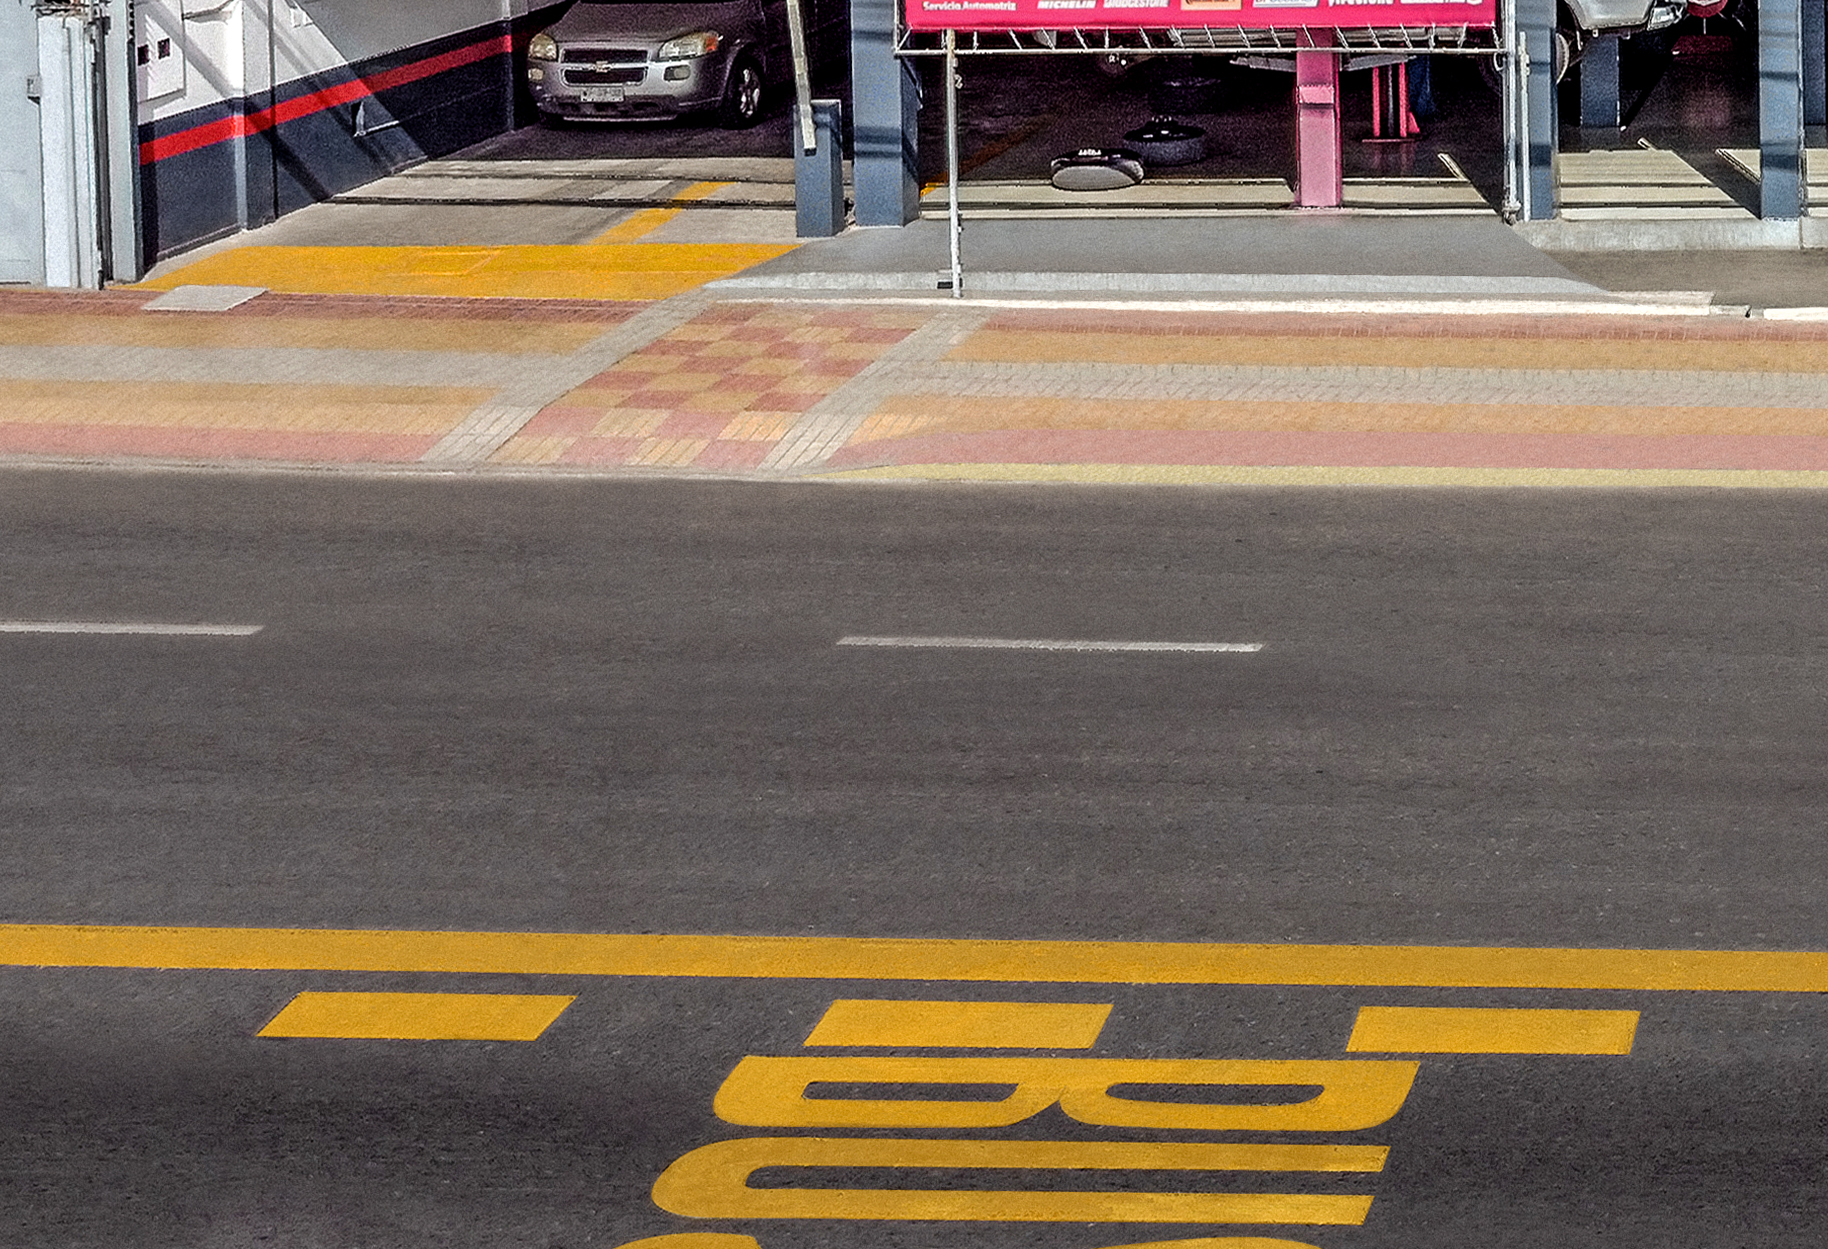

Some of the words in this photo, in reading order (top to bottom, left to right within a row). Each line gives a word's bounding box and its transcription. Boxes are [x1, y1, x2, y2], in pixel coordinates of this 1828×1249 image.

[923, 1, 961, 11] Servicio
[963, 1, 1017, 11] Automotriz
[1037, 0, 1097, 10] MICHELIN
[614, 1055, 1422, 1249] BU
